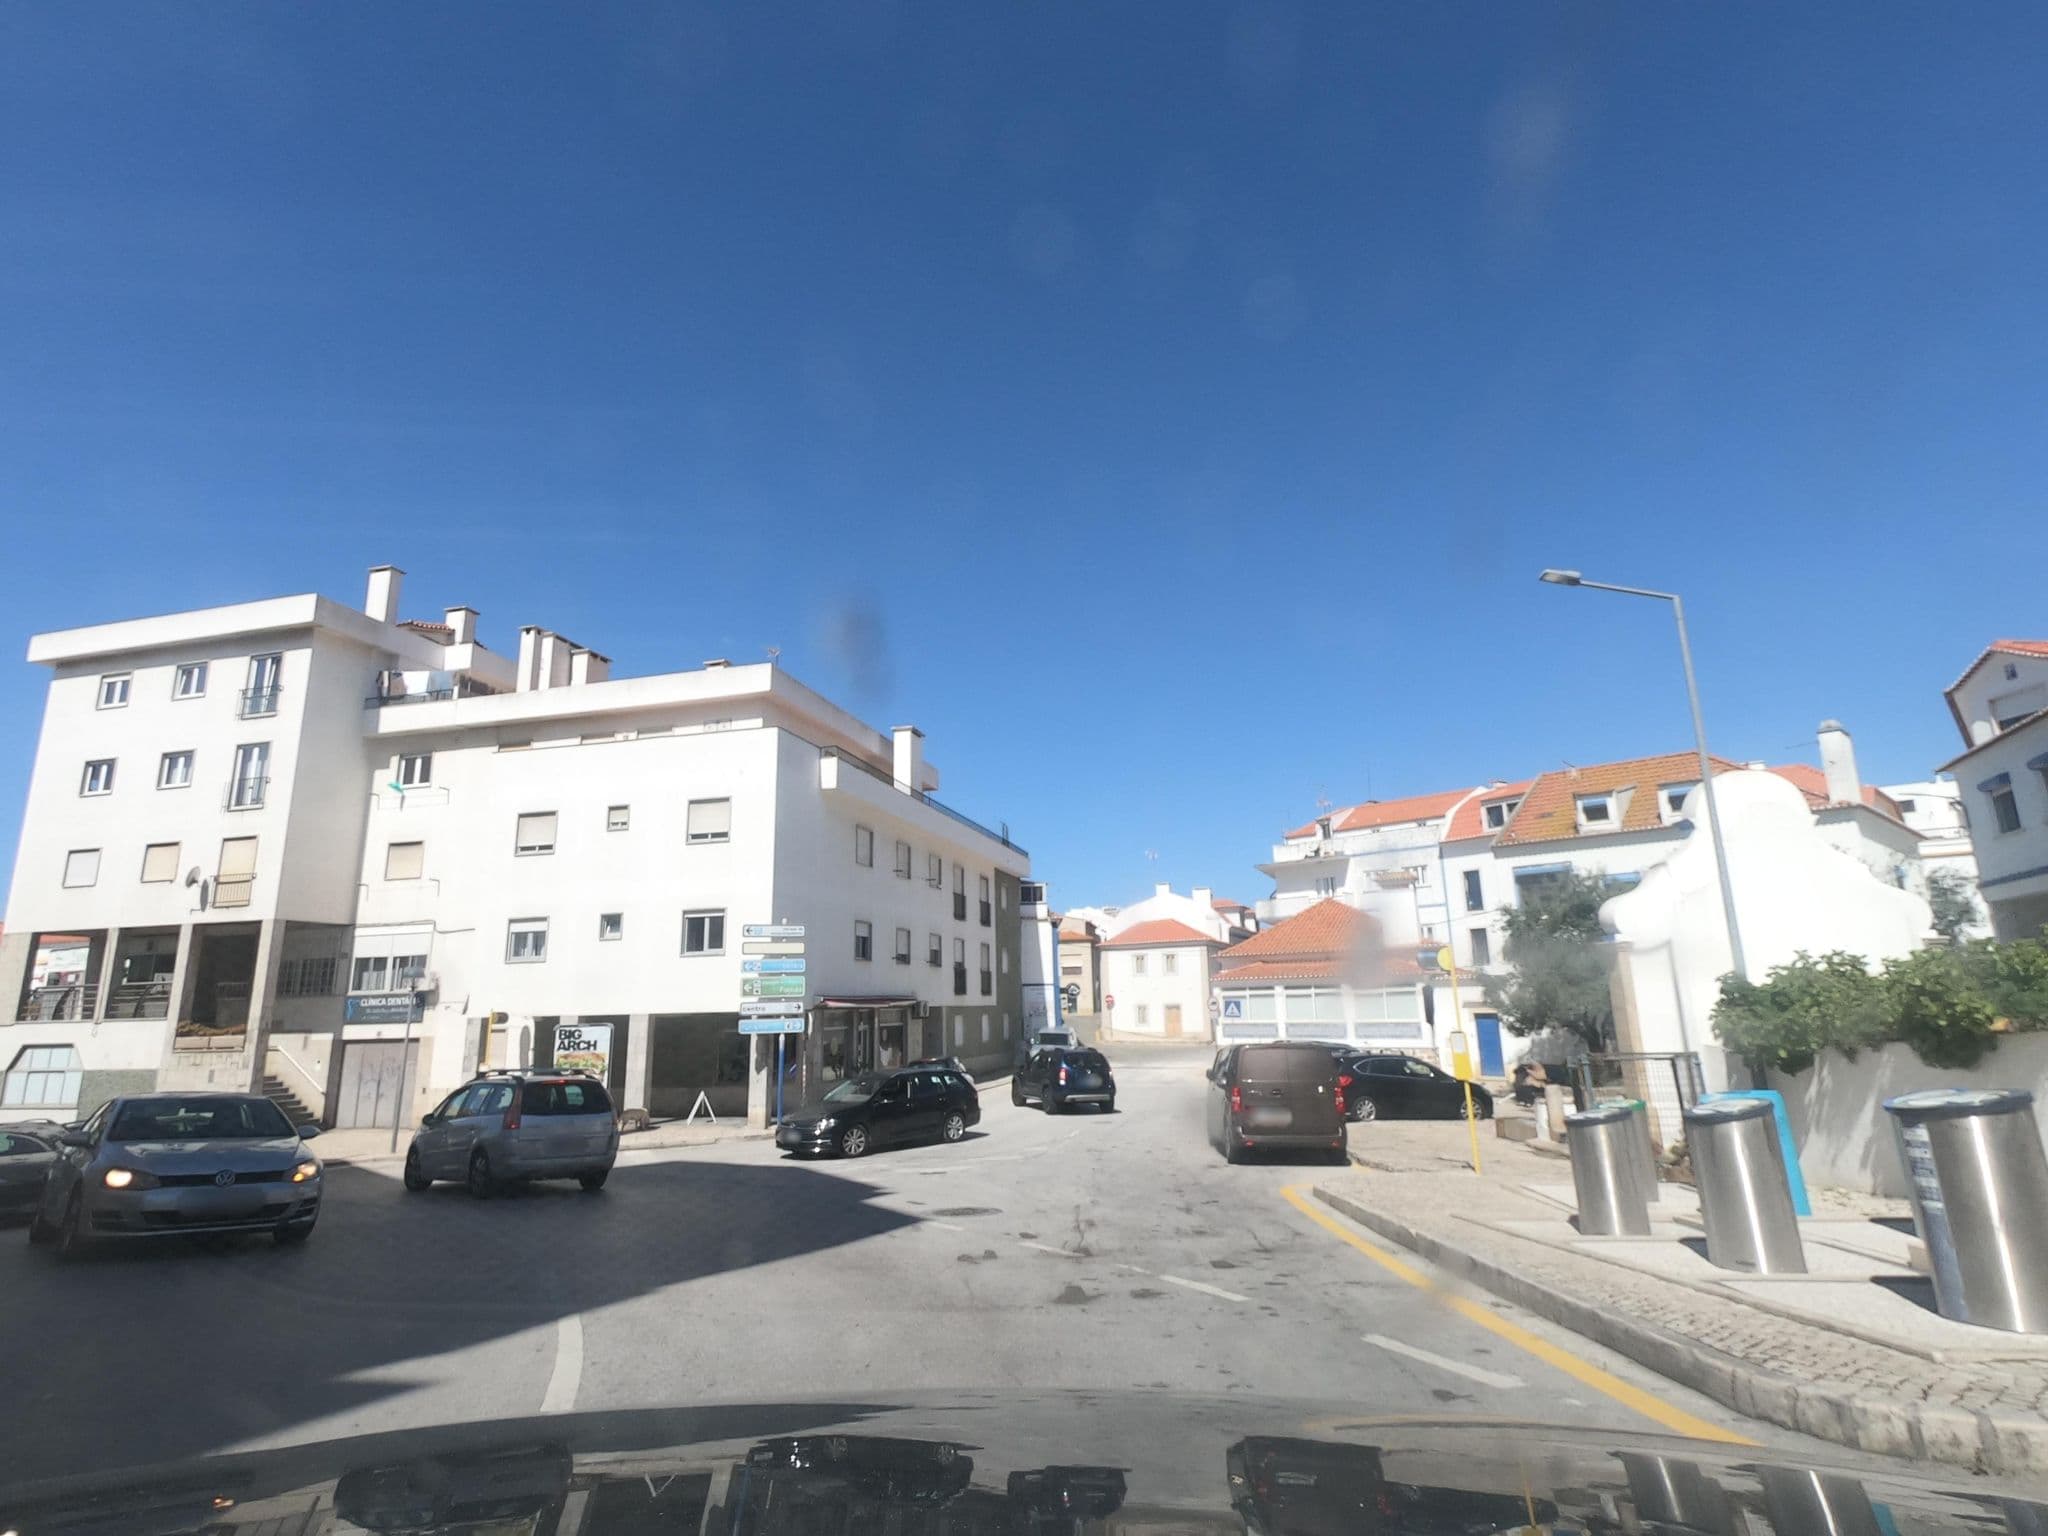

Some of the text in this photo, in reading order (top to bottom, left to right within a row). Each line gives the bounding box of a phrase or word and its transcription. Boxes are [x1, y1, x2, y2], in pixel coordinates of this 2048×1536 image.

[360, 997, 386, 1006] CLÍNICA
[559, 1029, 582, 1040] BIG
[557, 1040, 597, 1051] ARCH
